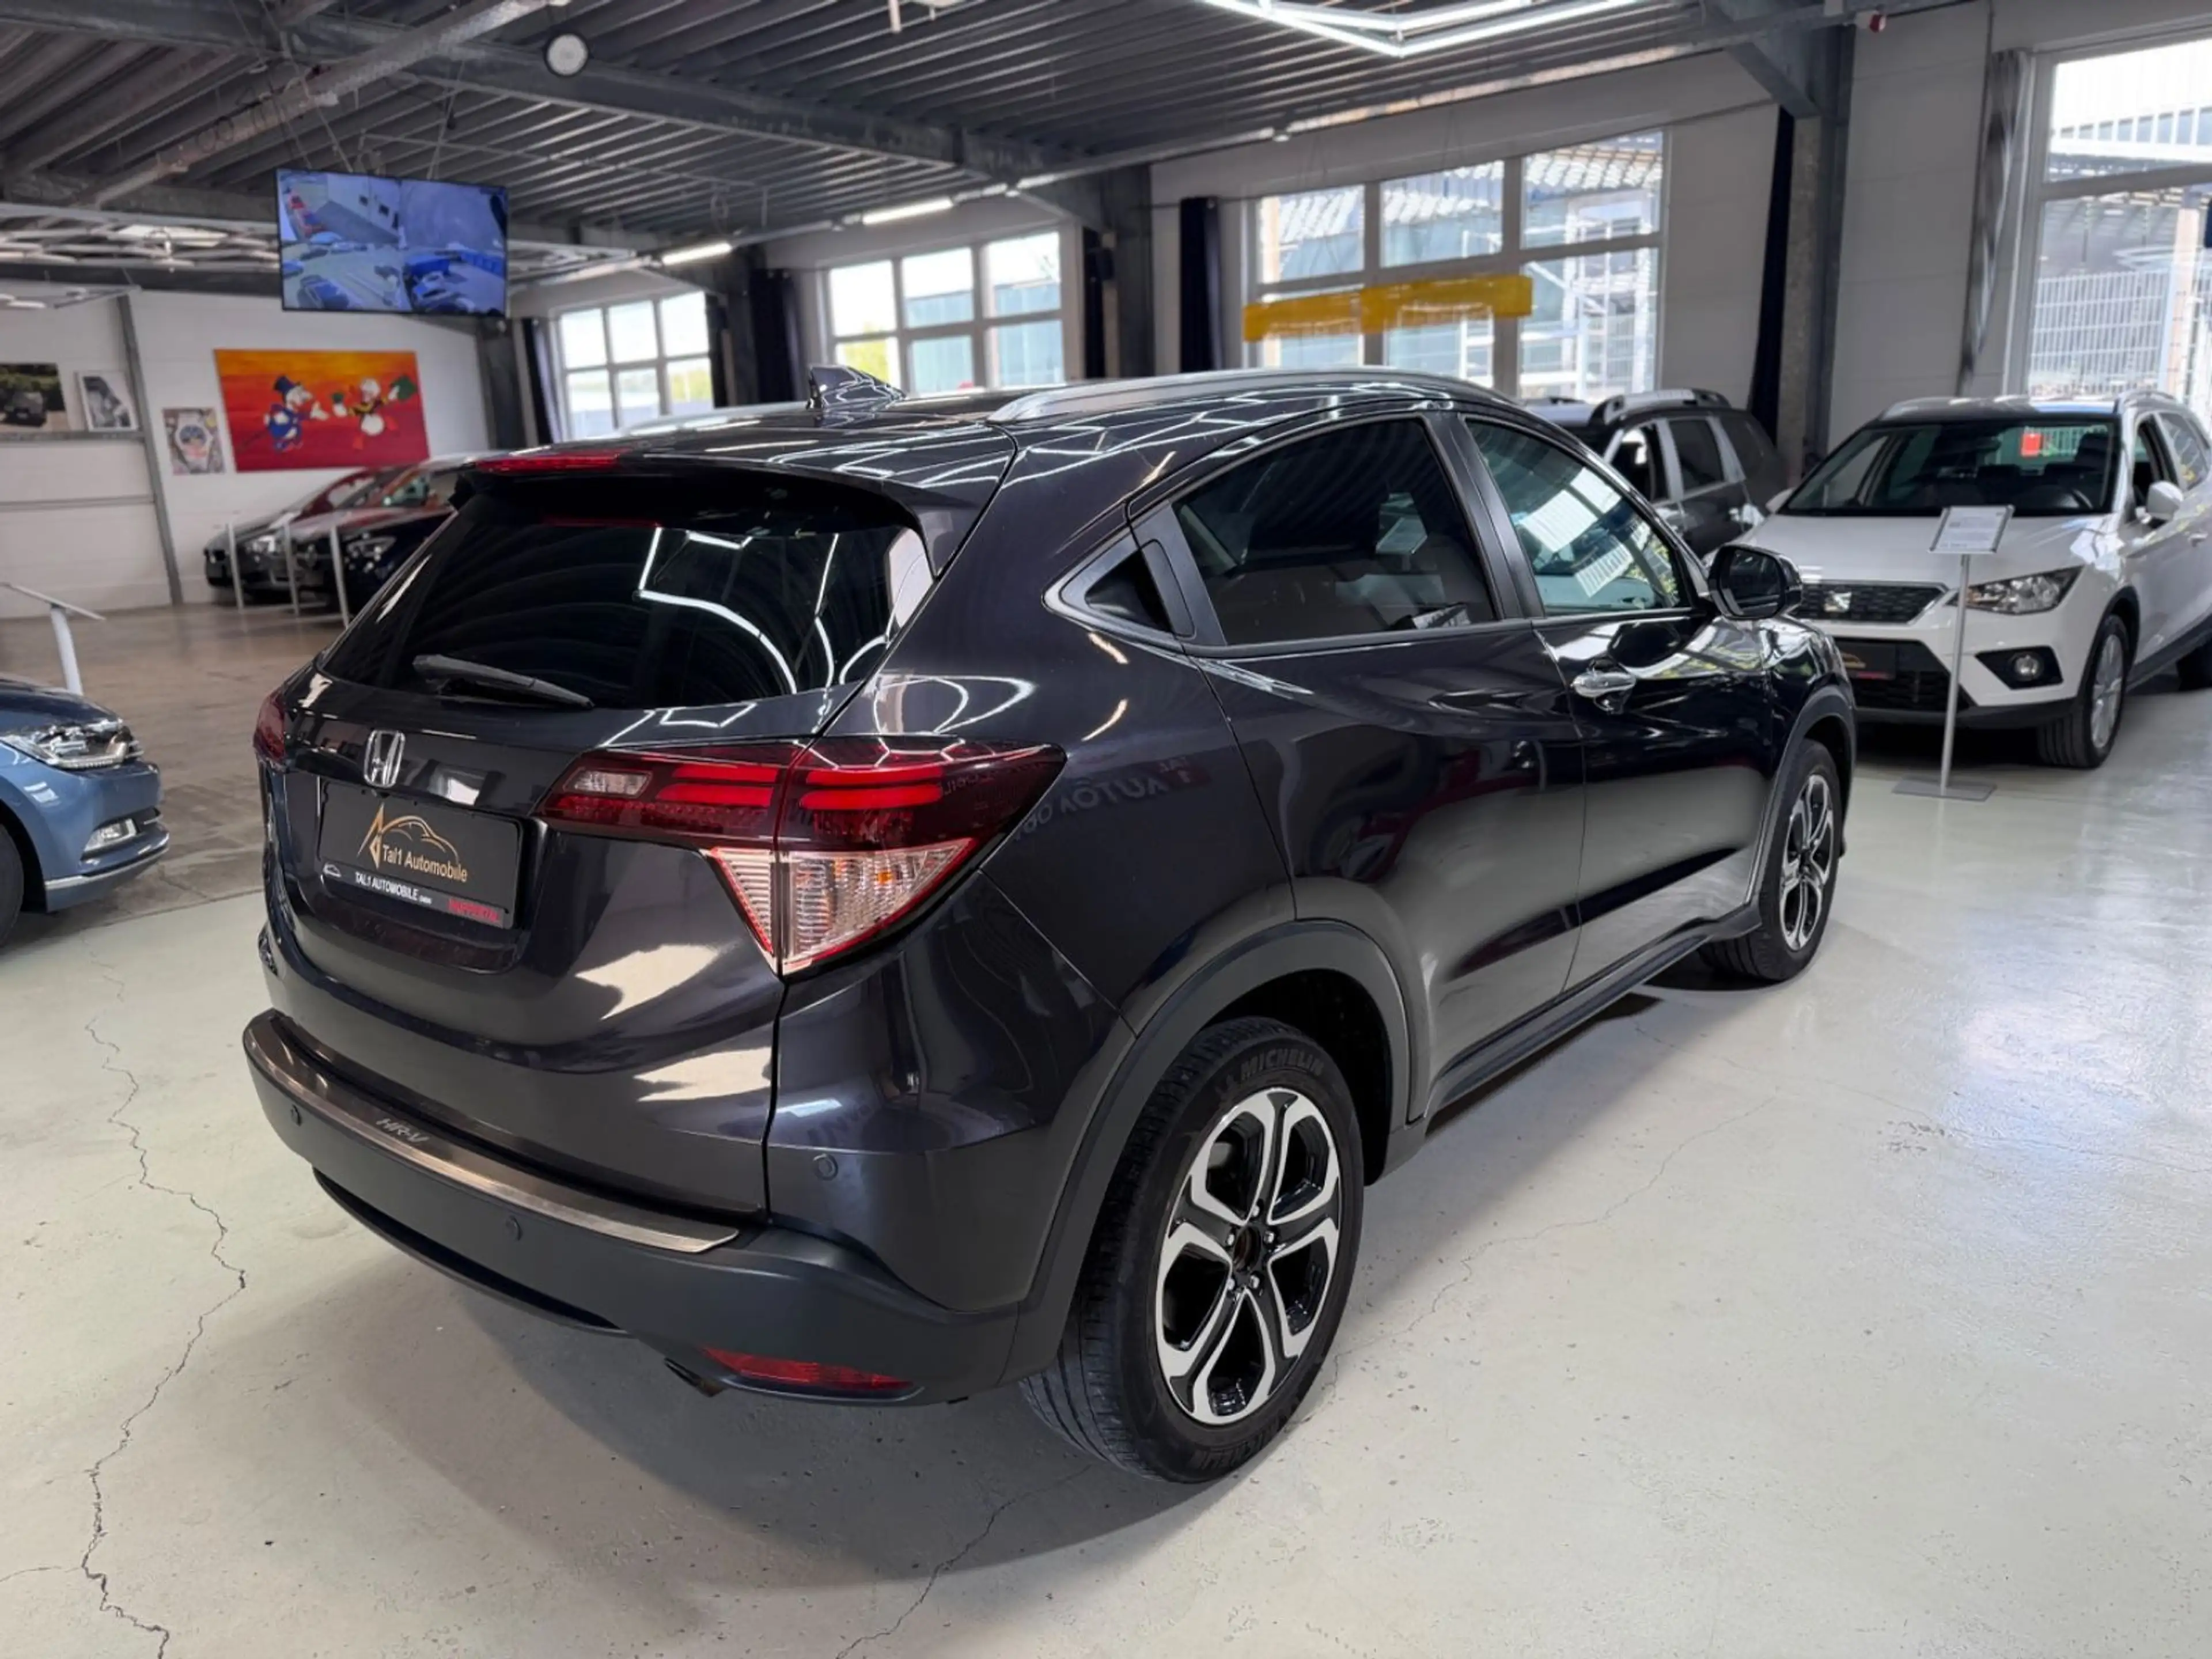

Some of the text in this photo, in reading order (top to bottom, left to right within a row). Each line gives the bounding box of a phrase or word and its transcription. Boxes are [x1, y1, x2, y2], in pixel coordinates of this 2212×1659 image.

[404, 851, 468, 883] Automobile
[372, 876, 420, 901] AUTOMOBILE
[1240, 1047, 1324, 1081] MICHELIN
[375, 1118, 430, 1142] HR-V
